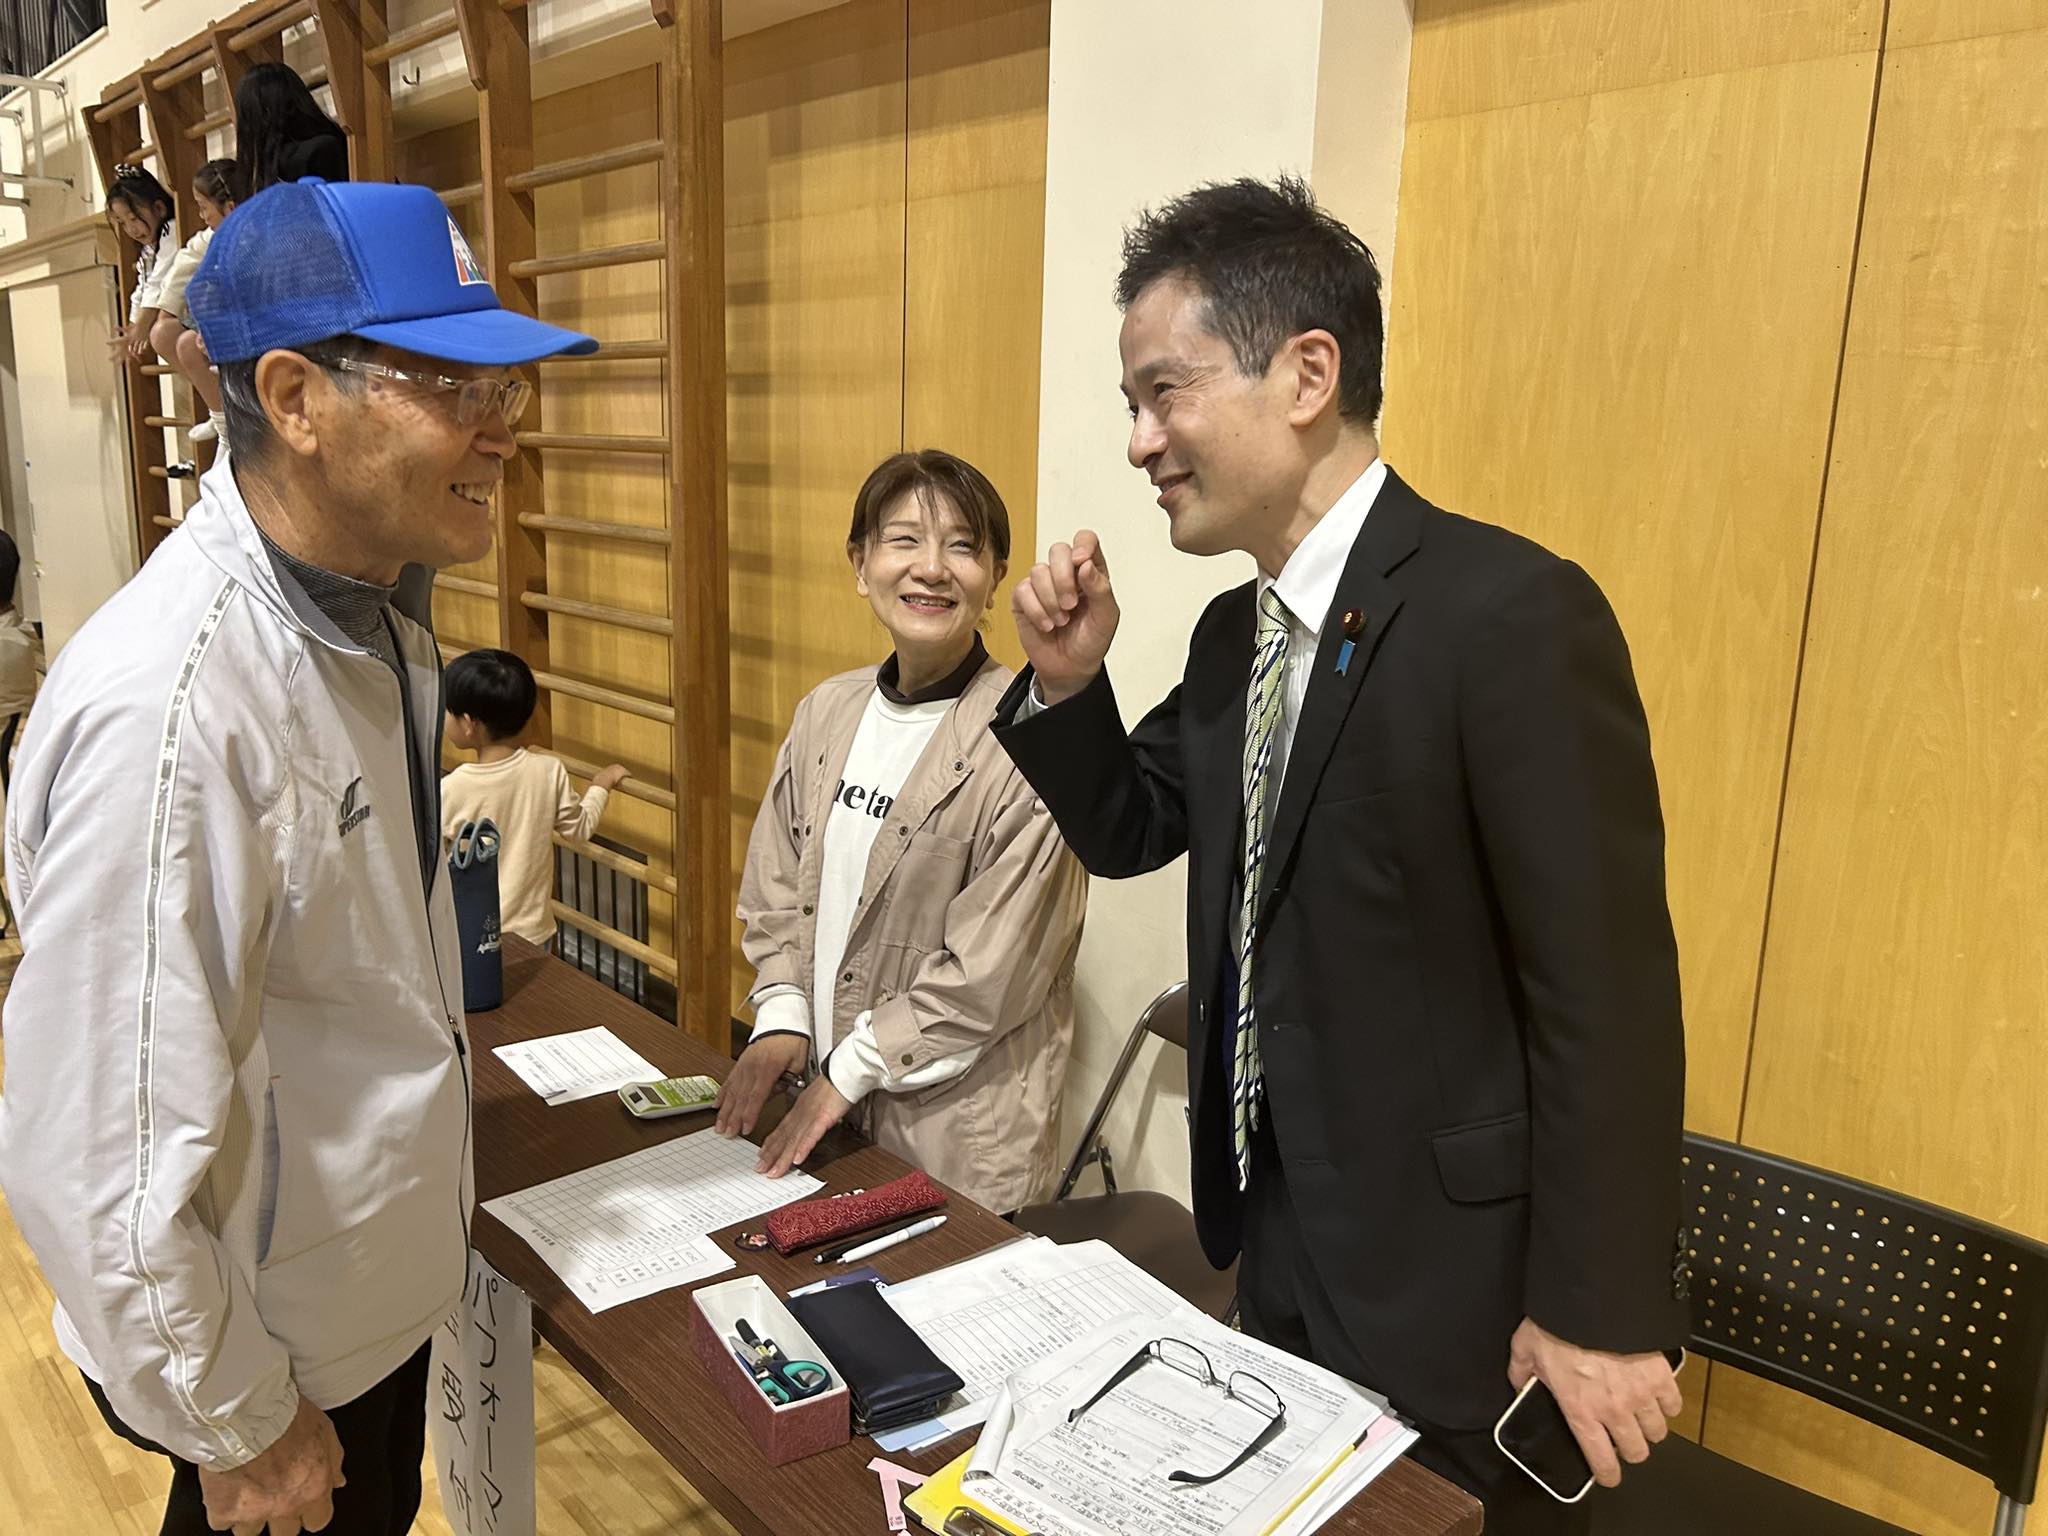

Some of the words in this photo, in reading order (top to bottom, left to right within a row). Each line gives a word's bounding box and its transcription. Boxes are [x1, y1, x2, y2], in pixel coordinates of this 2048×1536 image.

[472, 1271, 503, 1534] パフォーマ
